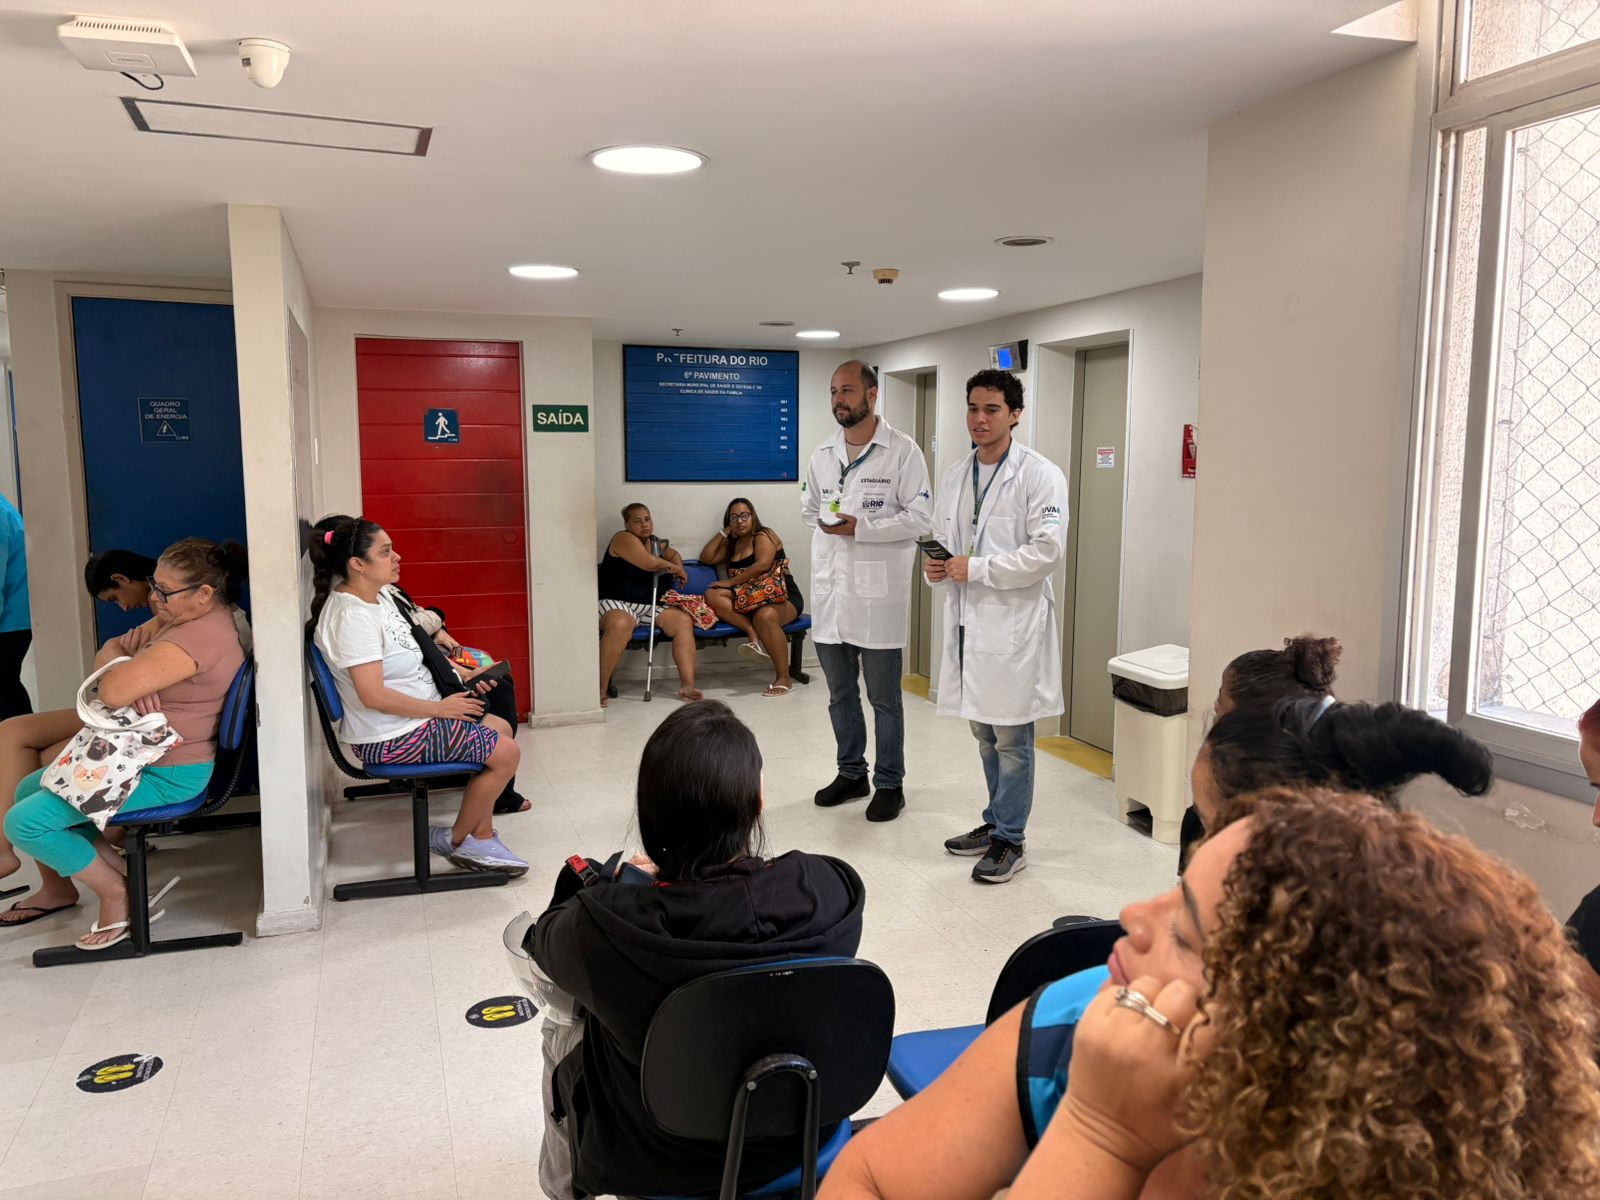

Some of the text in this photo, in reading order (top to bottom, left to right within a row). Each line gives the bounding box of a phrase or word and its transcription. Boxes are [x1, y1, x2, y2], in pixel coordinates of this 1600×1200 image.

[656, 353, 768, 366] PFEITURA DO RIO
[694, 372, 740, 380] PAVIMENTO
[537, 409, 584, 425] SAÍDA
